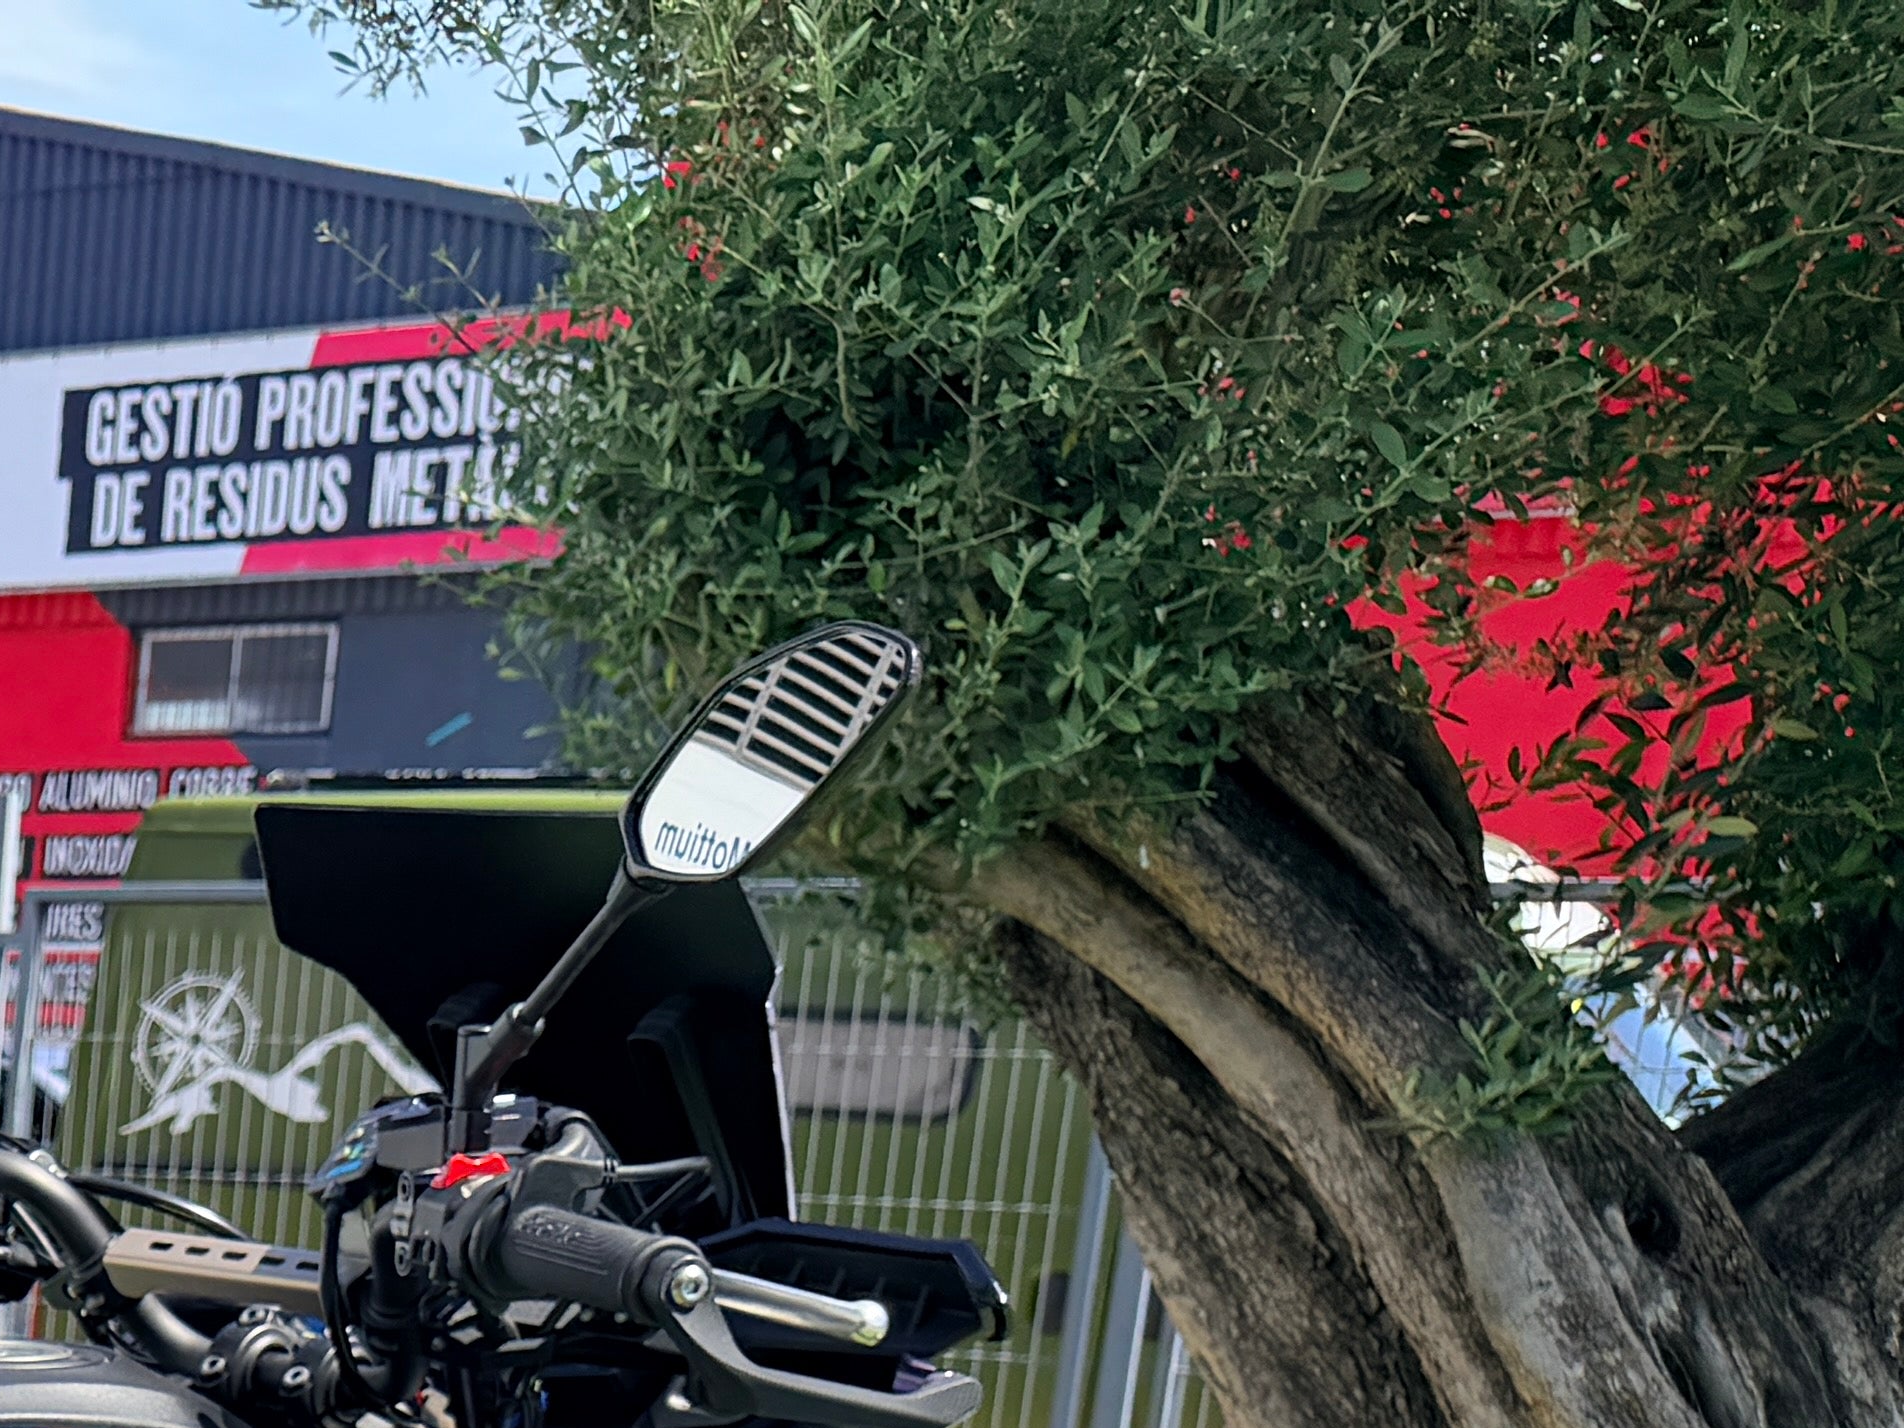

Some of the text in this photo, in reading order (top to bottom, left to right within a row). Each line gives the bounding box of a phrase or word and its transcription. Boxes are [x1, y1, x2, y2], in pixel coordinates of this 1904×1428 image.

[85, 373, 242, 466] GESTIÓ
[90, 470, 151, 548] DE
[161, 453, 353, 544] RESIDUS
